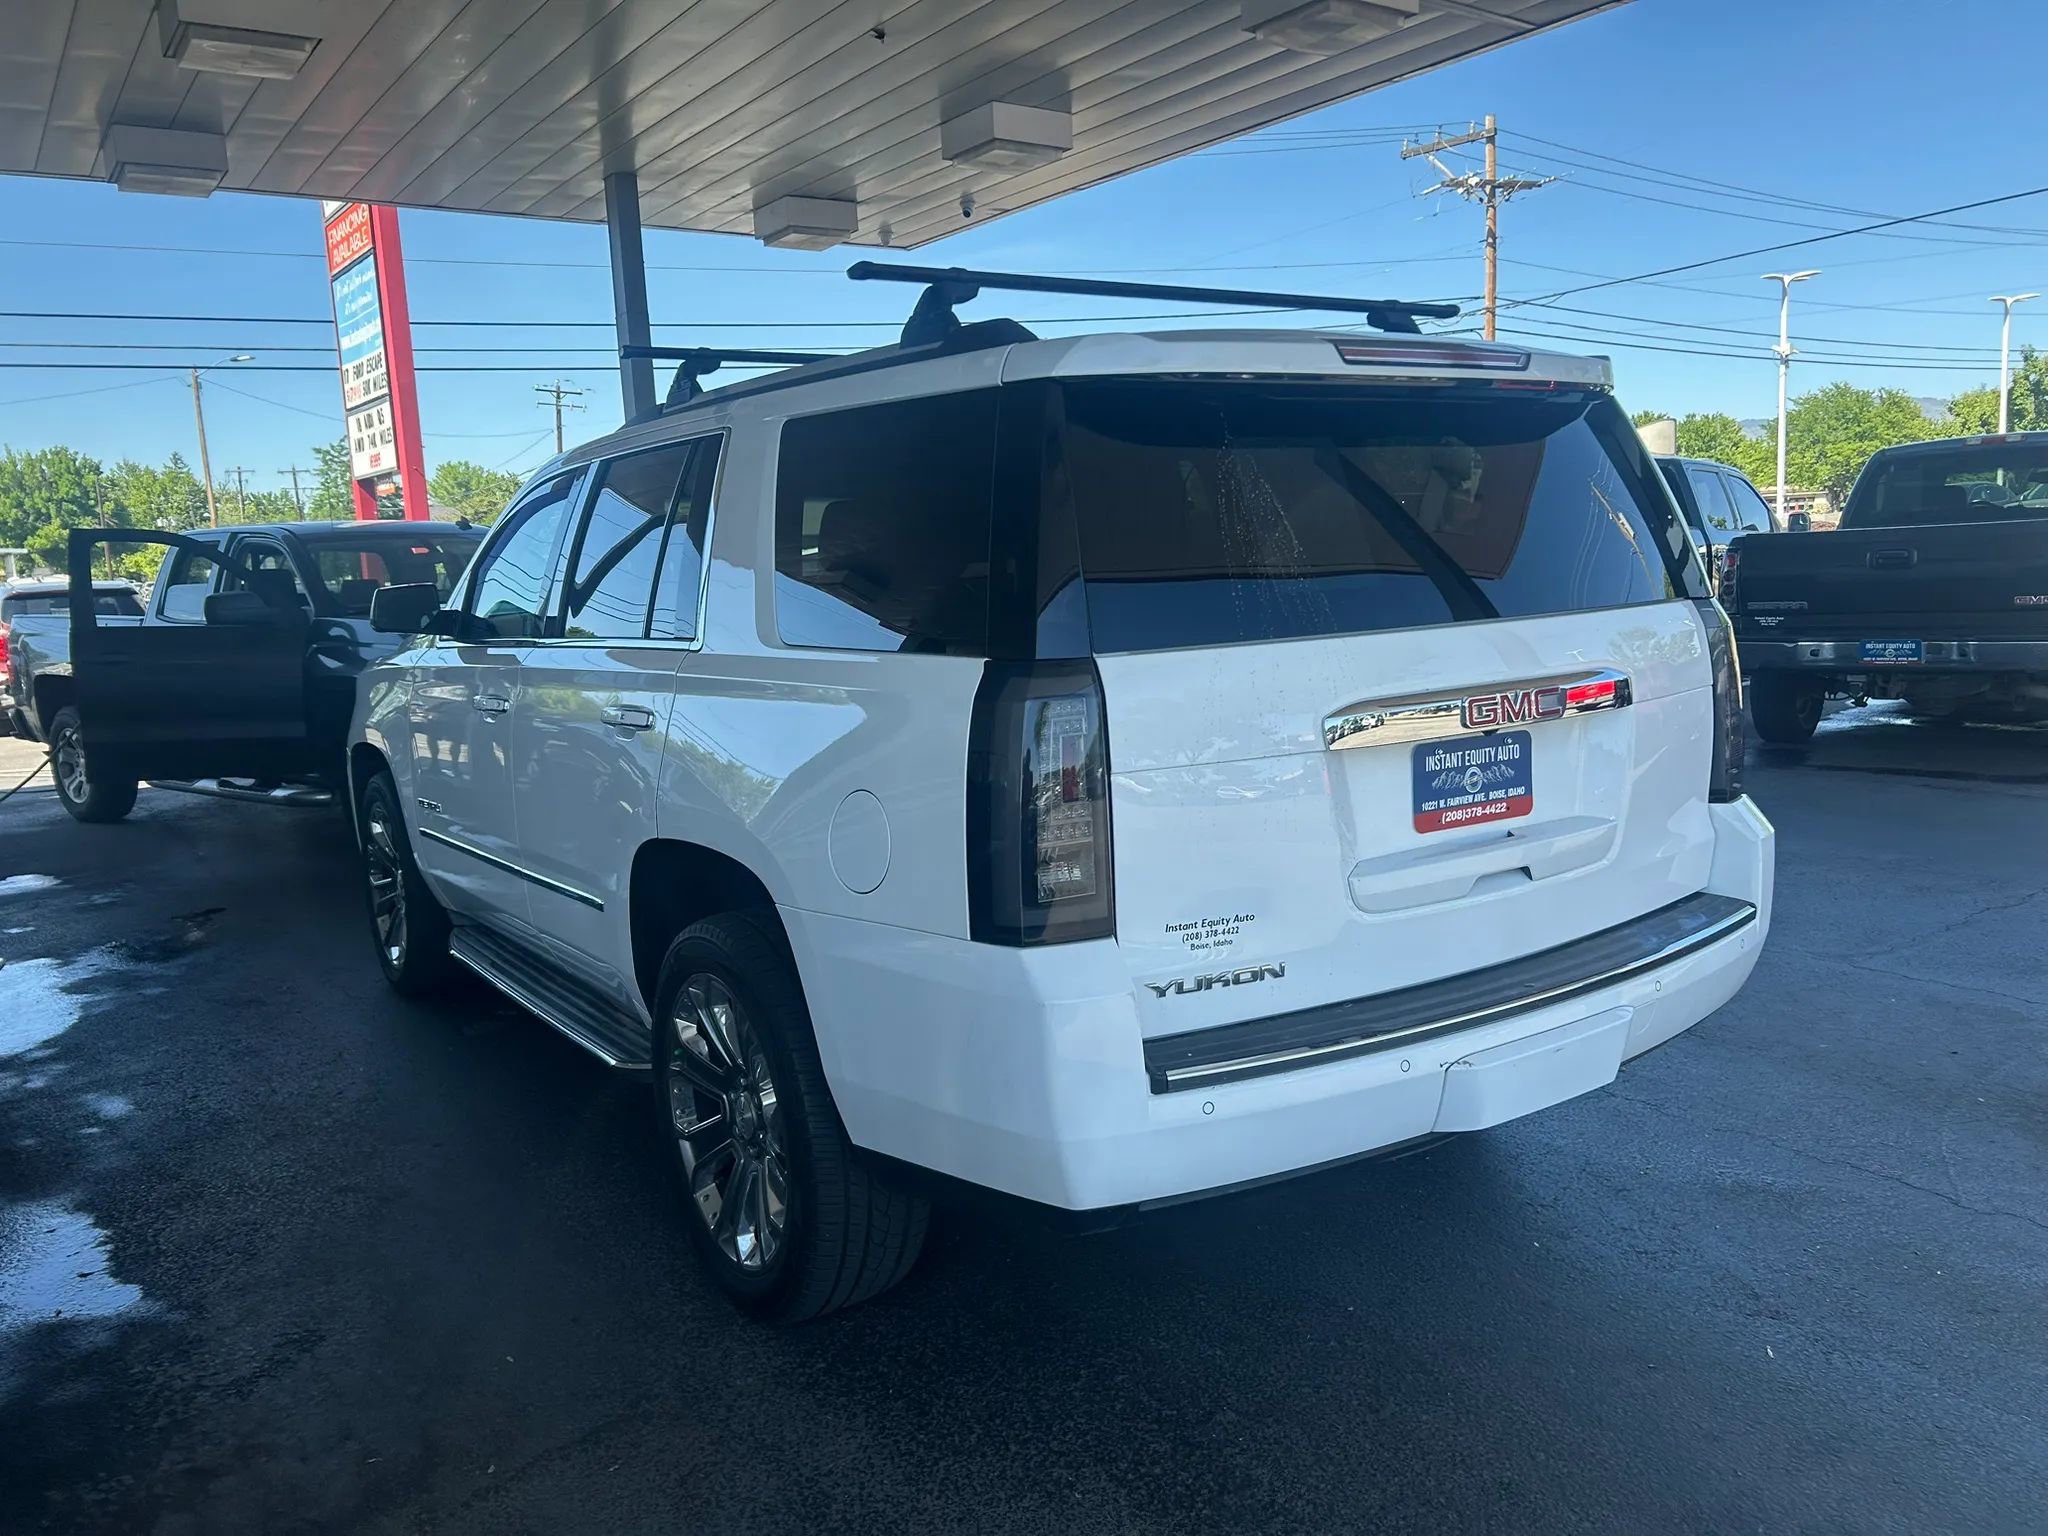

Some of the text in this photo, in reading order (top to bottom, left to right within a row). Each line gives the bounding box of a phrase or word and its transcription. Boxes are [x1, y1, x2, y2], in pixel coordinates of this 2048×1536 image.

[328, 203, 370, 246] FINANCING
[333, 226, 369, 266] AVAILABLE
[366, 352, 383, 374] ESCAPE
[373, 372, 388, 392] MILES
[379, 426, 393, 446] MILES
[1466, 685, 1563, 729] GMC
[1425, 743, 1520, 772] INSTANT EQUITY AUTO
[1421, 801, 1438, 812] 10221
[1446, 794, 1473, 807] FAIRVIEW
[1489, 789, 1507, 801] BOISE,
[1508, 786, 1525, 797] IDAHO
[1441, 802, 1507, 824] (208)378-4422
[1165, 913, 1255, 933] Instant Equity Auto
[1182, 926, 1240, 944] (208) 378-4422
[1190, 938, 1233, 951] Boise, Idaho
[1144, 961, 1286, 999] YUKON
